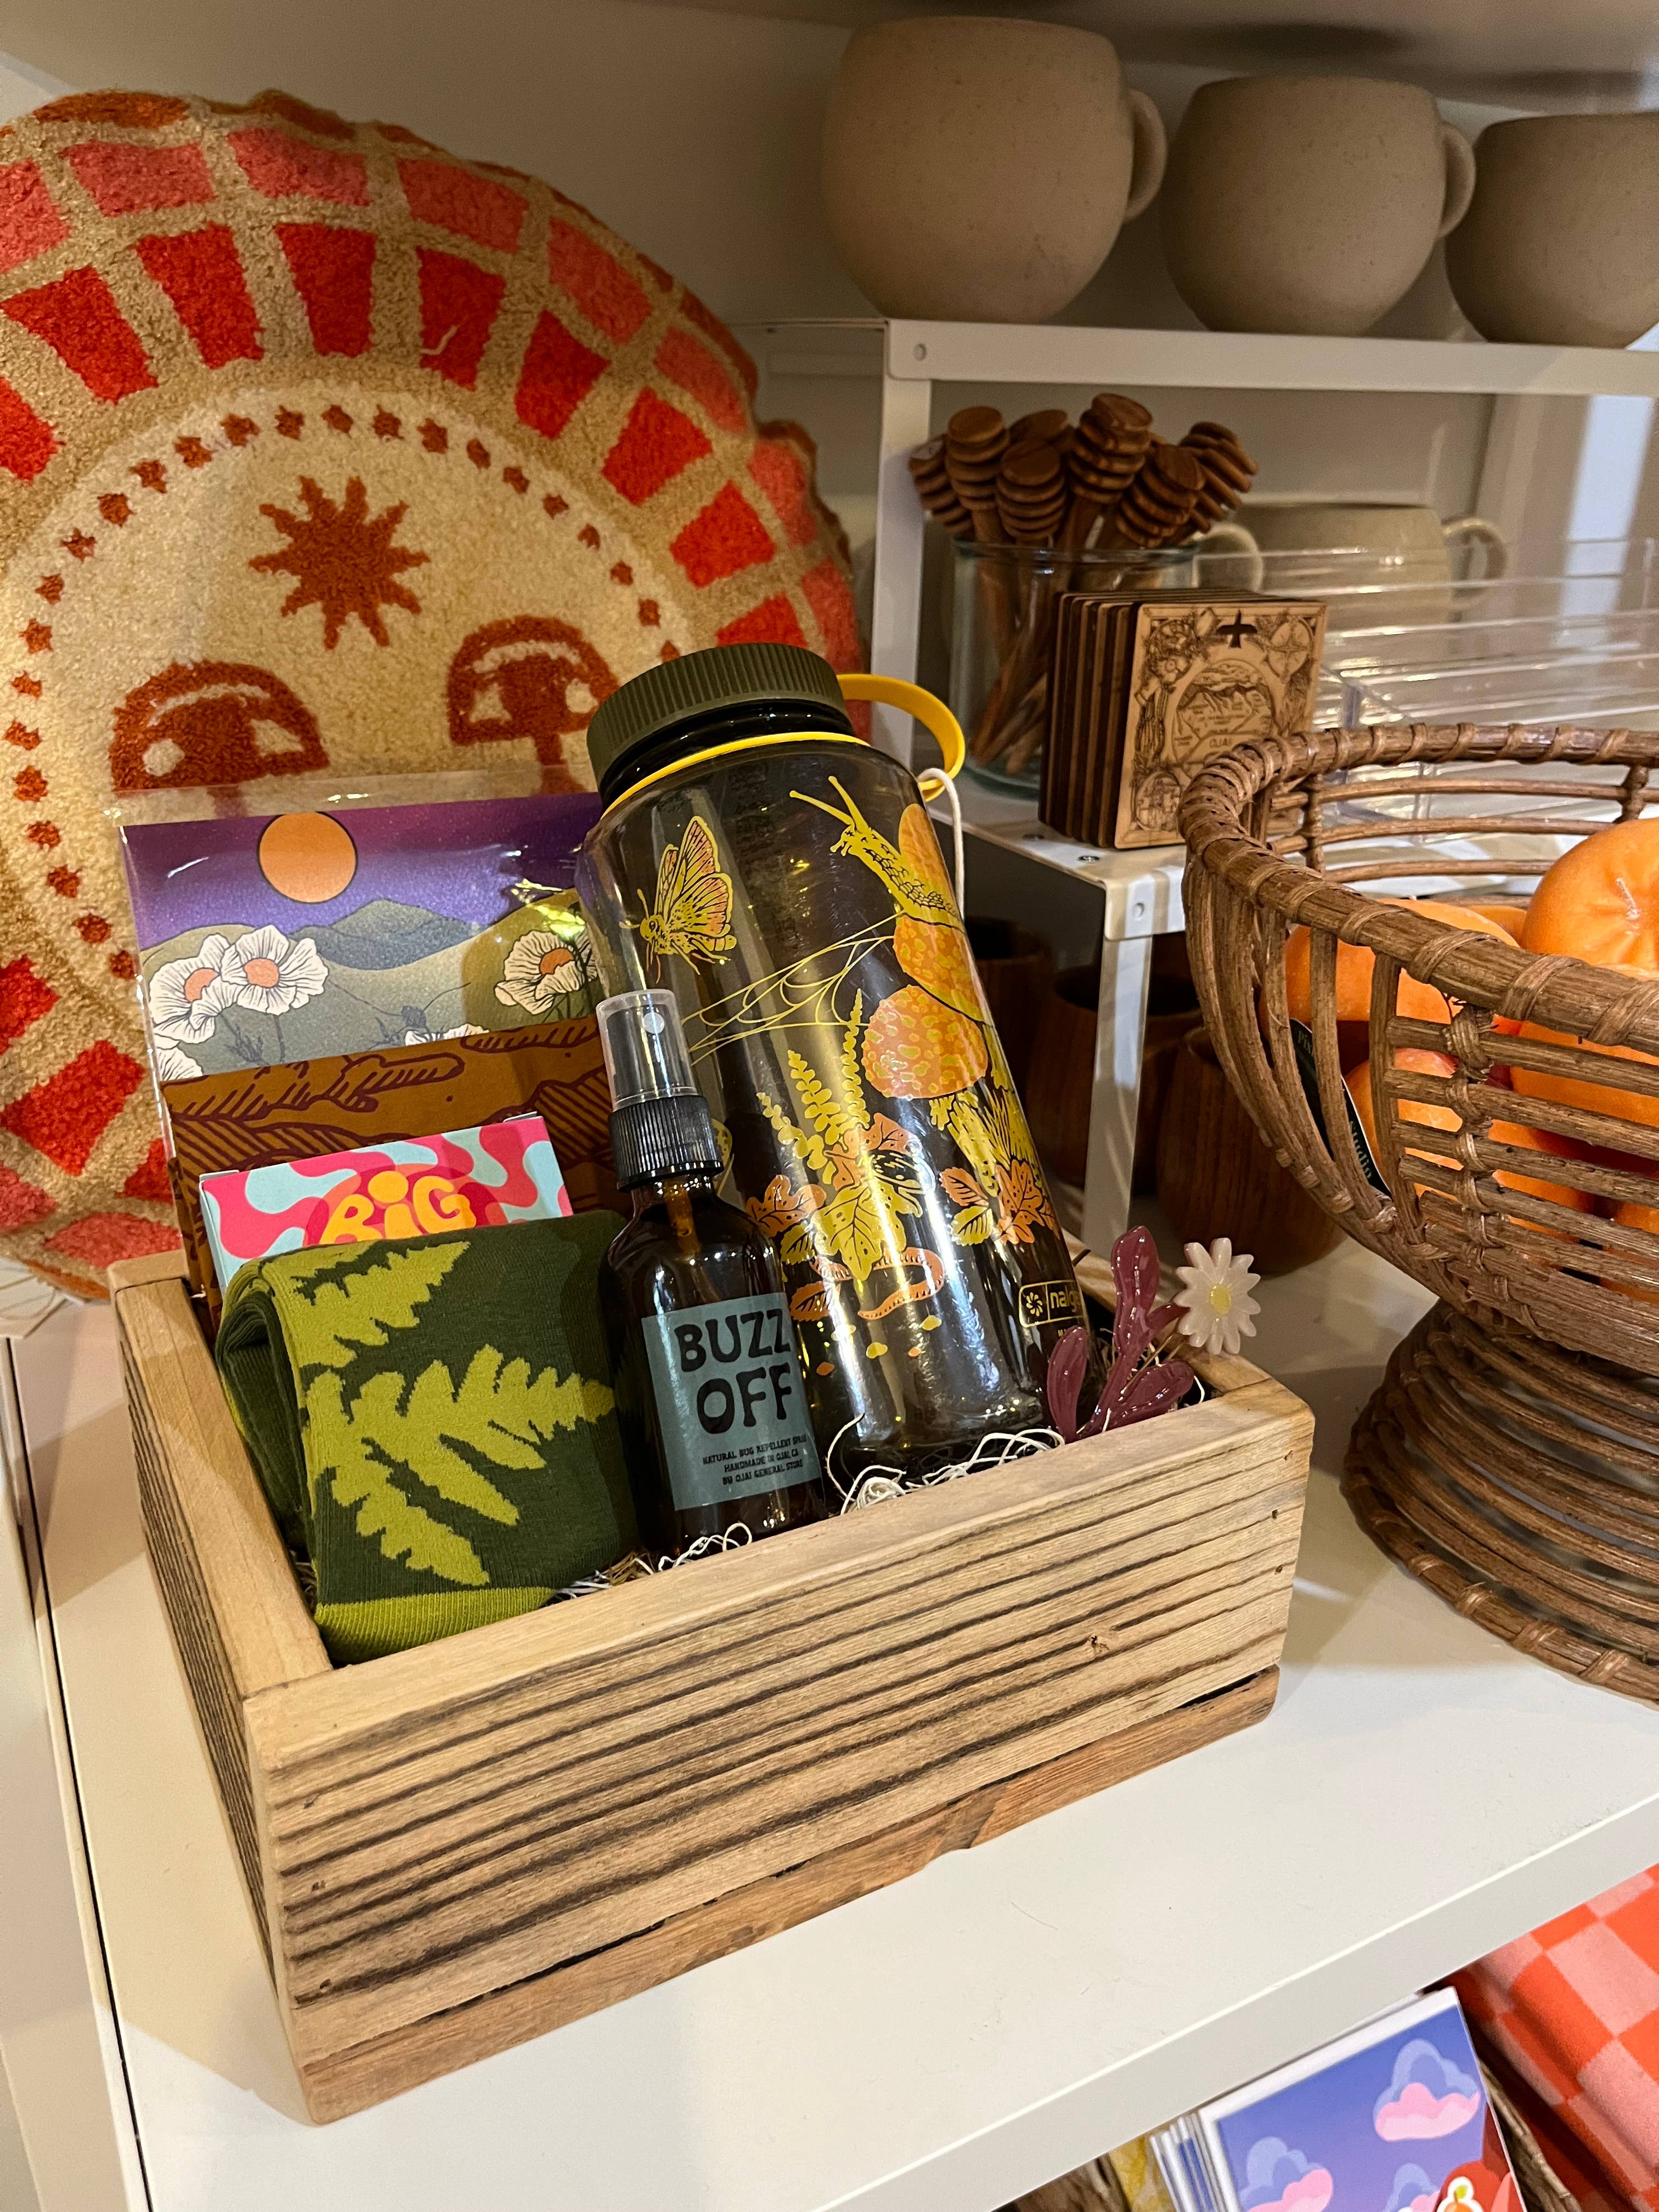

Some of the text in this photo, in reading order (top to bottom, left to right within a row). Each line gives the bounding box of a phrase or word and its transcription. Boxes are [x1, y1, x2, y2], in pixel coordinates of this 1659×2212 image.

[1050, 1285, 1077, 1313] nalg
[674, 1308, 791, 1372] BUZZ
[697, 1362, 792, 1434] OFF
[702, 1451, 737, 1465] NATURAL
[739, 1447, 754, 1457] BUG
[756, 1437, 791, 1453] REPELLENT
[724, 1456, 766, 1472] HANDMADE
[735, 1472, 752, 1482] OJAI
[754, 1464, 785, 1478] GENERAL
[786, 1459, 804, 1470] STORE
